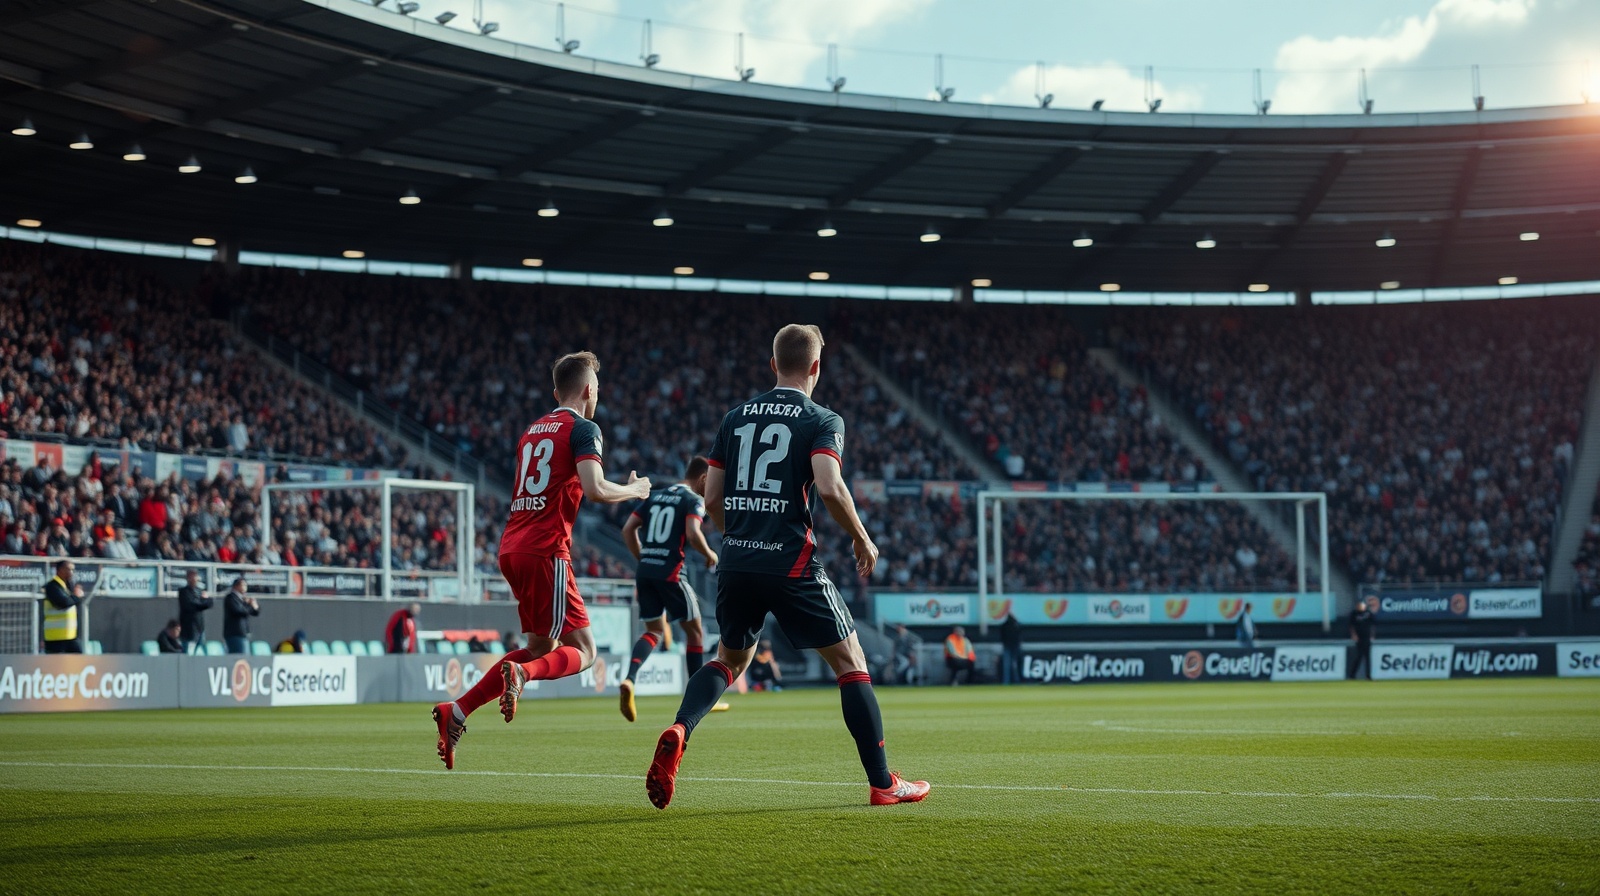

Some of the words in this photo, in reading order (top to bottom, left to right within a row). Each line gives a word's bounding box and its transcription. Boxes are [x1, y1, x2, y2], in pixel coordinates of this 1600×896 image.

[517, 438, 554, 496] 13
[733, 422, 793, 494] 12
[646, 504, 676, 544] 10
